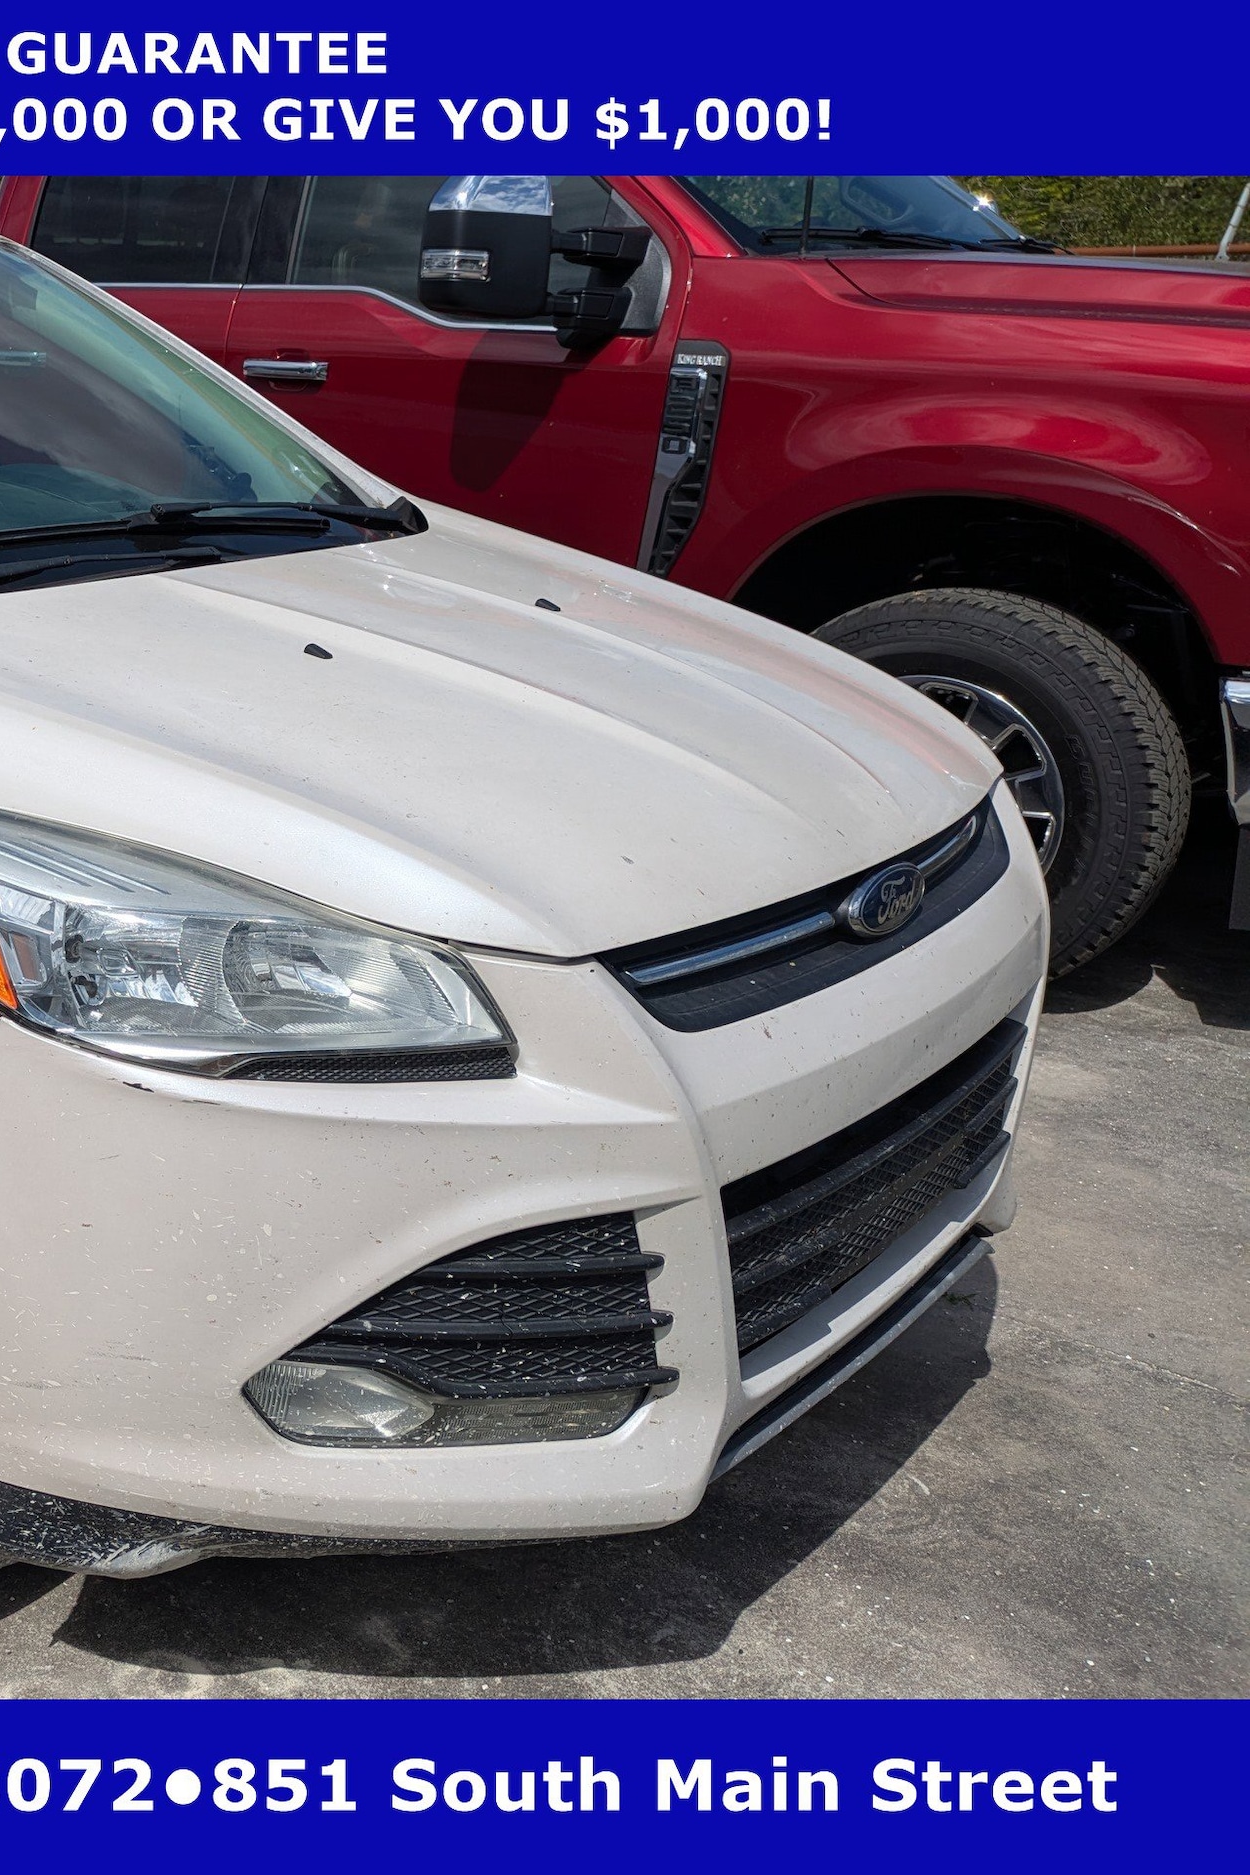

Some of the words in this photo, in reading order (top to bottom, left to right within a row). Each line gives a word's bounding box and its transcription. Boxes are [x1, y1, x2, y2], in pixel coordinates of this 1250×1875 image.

[677, 354, 696, 365] KING
[696, 355, 722, 366] RANCH
[877, 875, 916, 925] Ford
